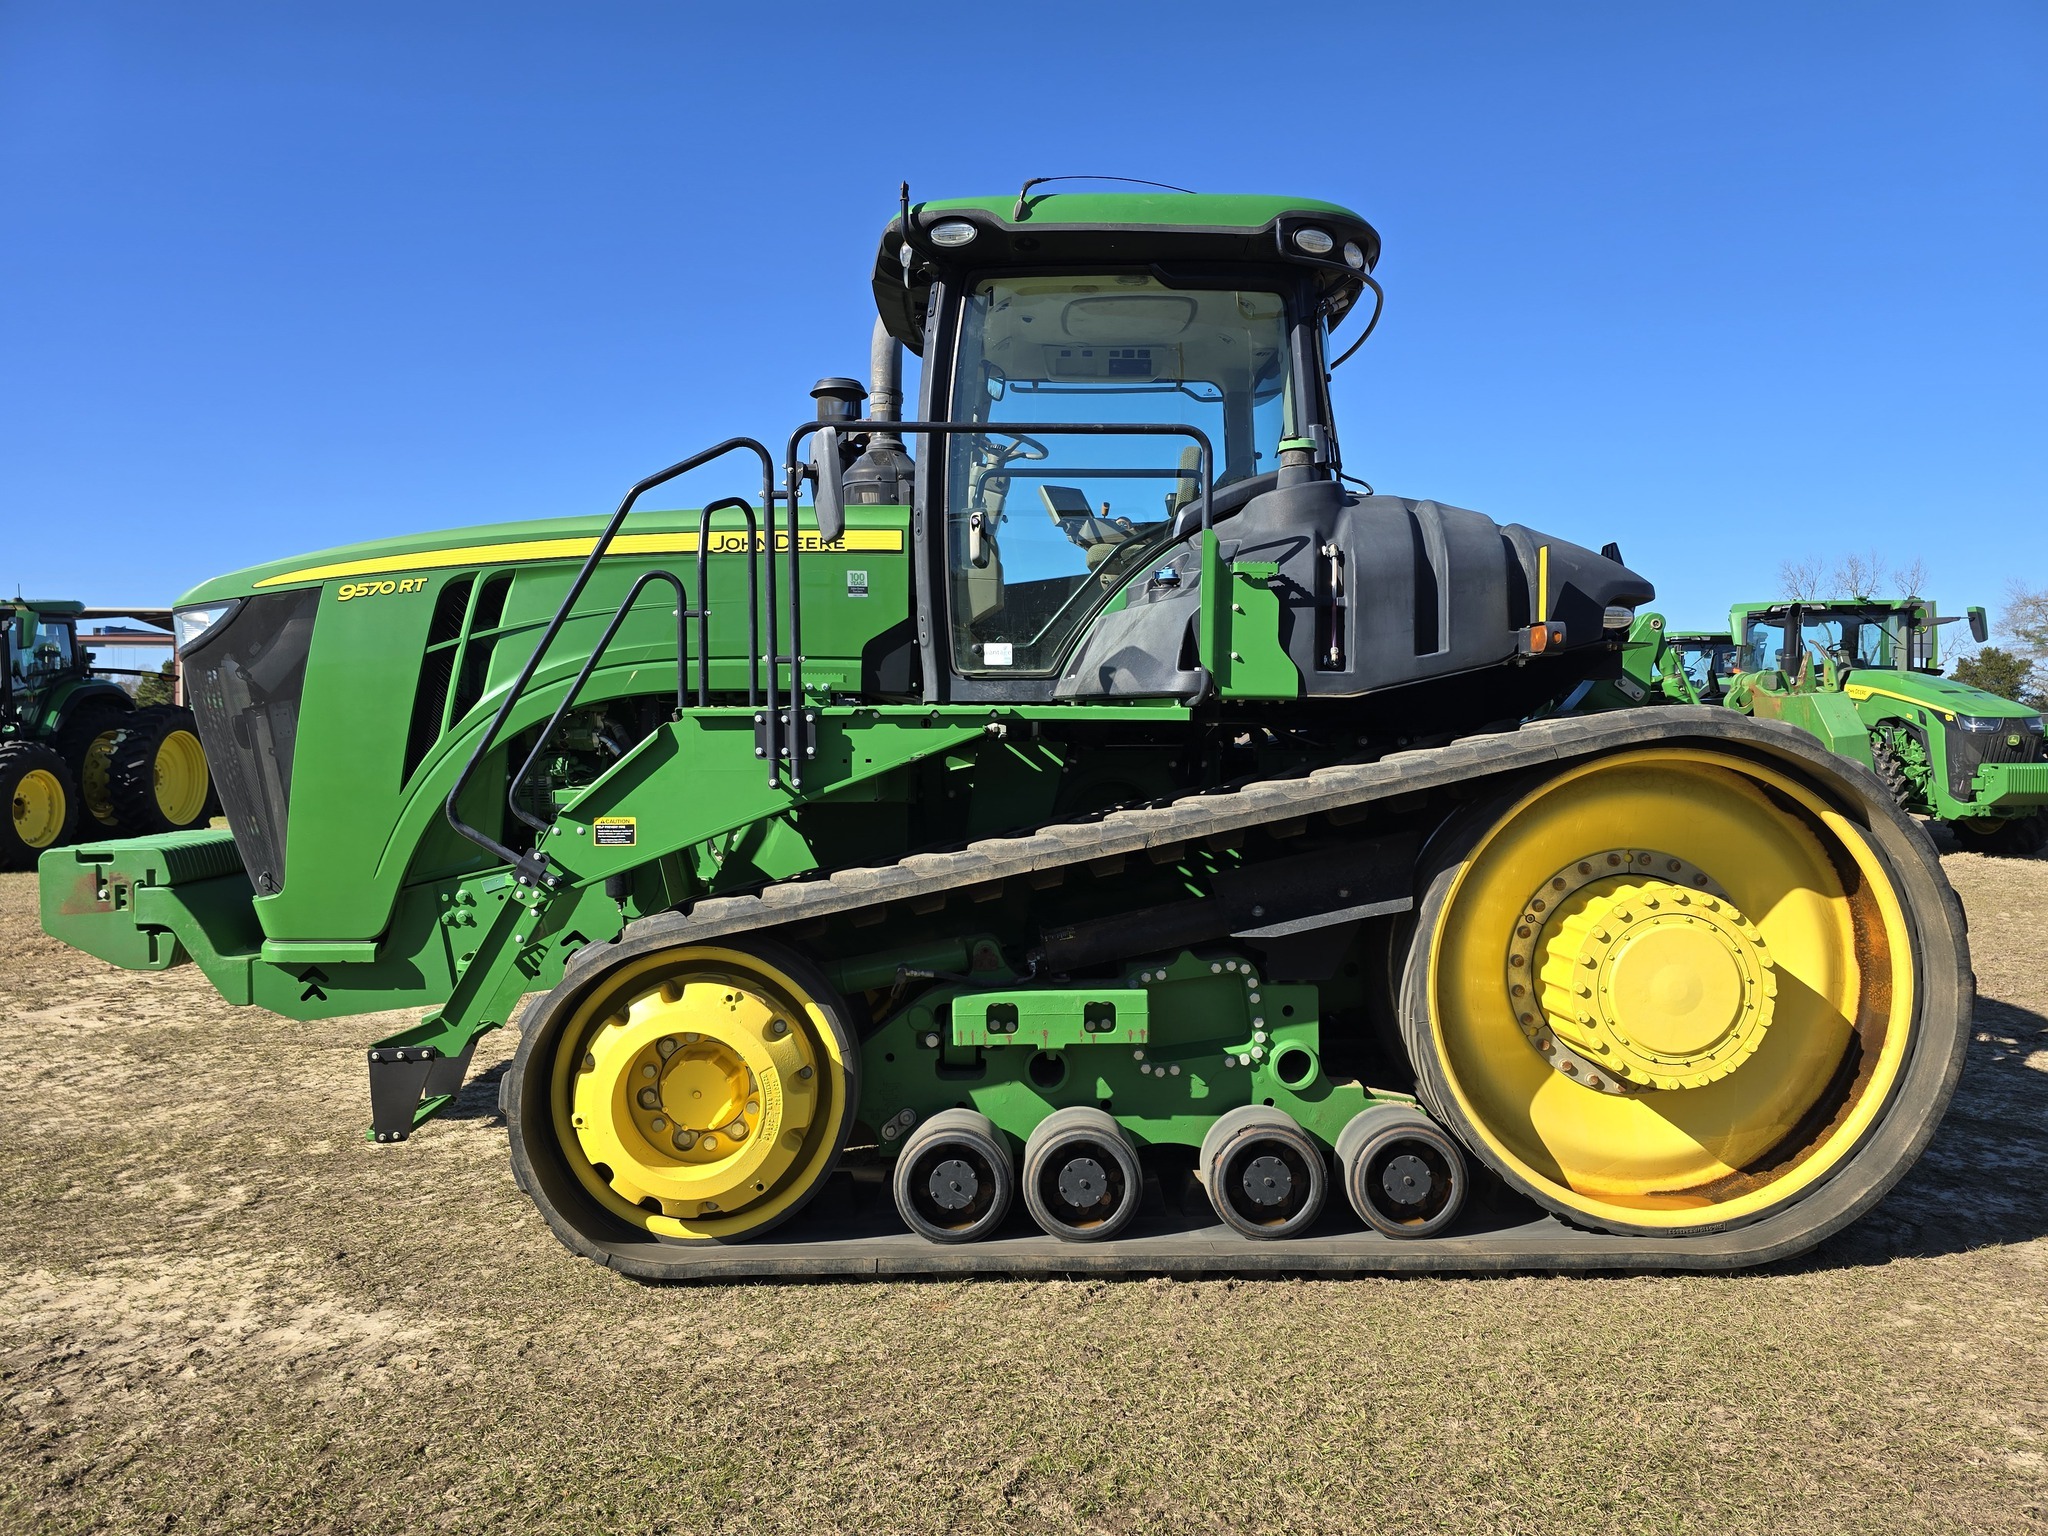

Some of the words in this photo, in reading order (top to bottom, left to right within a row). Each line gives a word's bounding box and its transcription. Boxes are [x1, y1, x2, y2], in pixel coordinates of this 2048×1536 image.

[775, 534, 845, 549] DEERE
[849, 572, 865, 581] 100
[337, 581, 397, 602] 9570
[398, 577, 429, 594] RT
